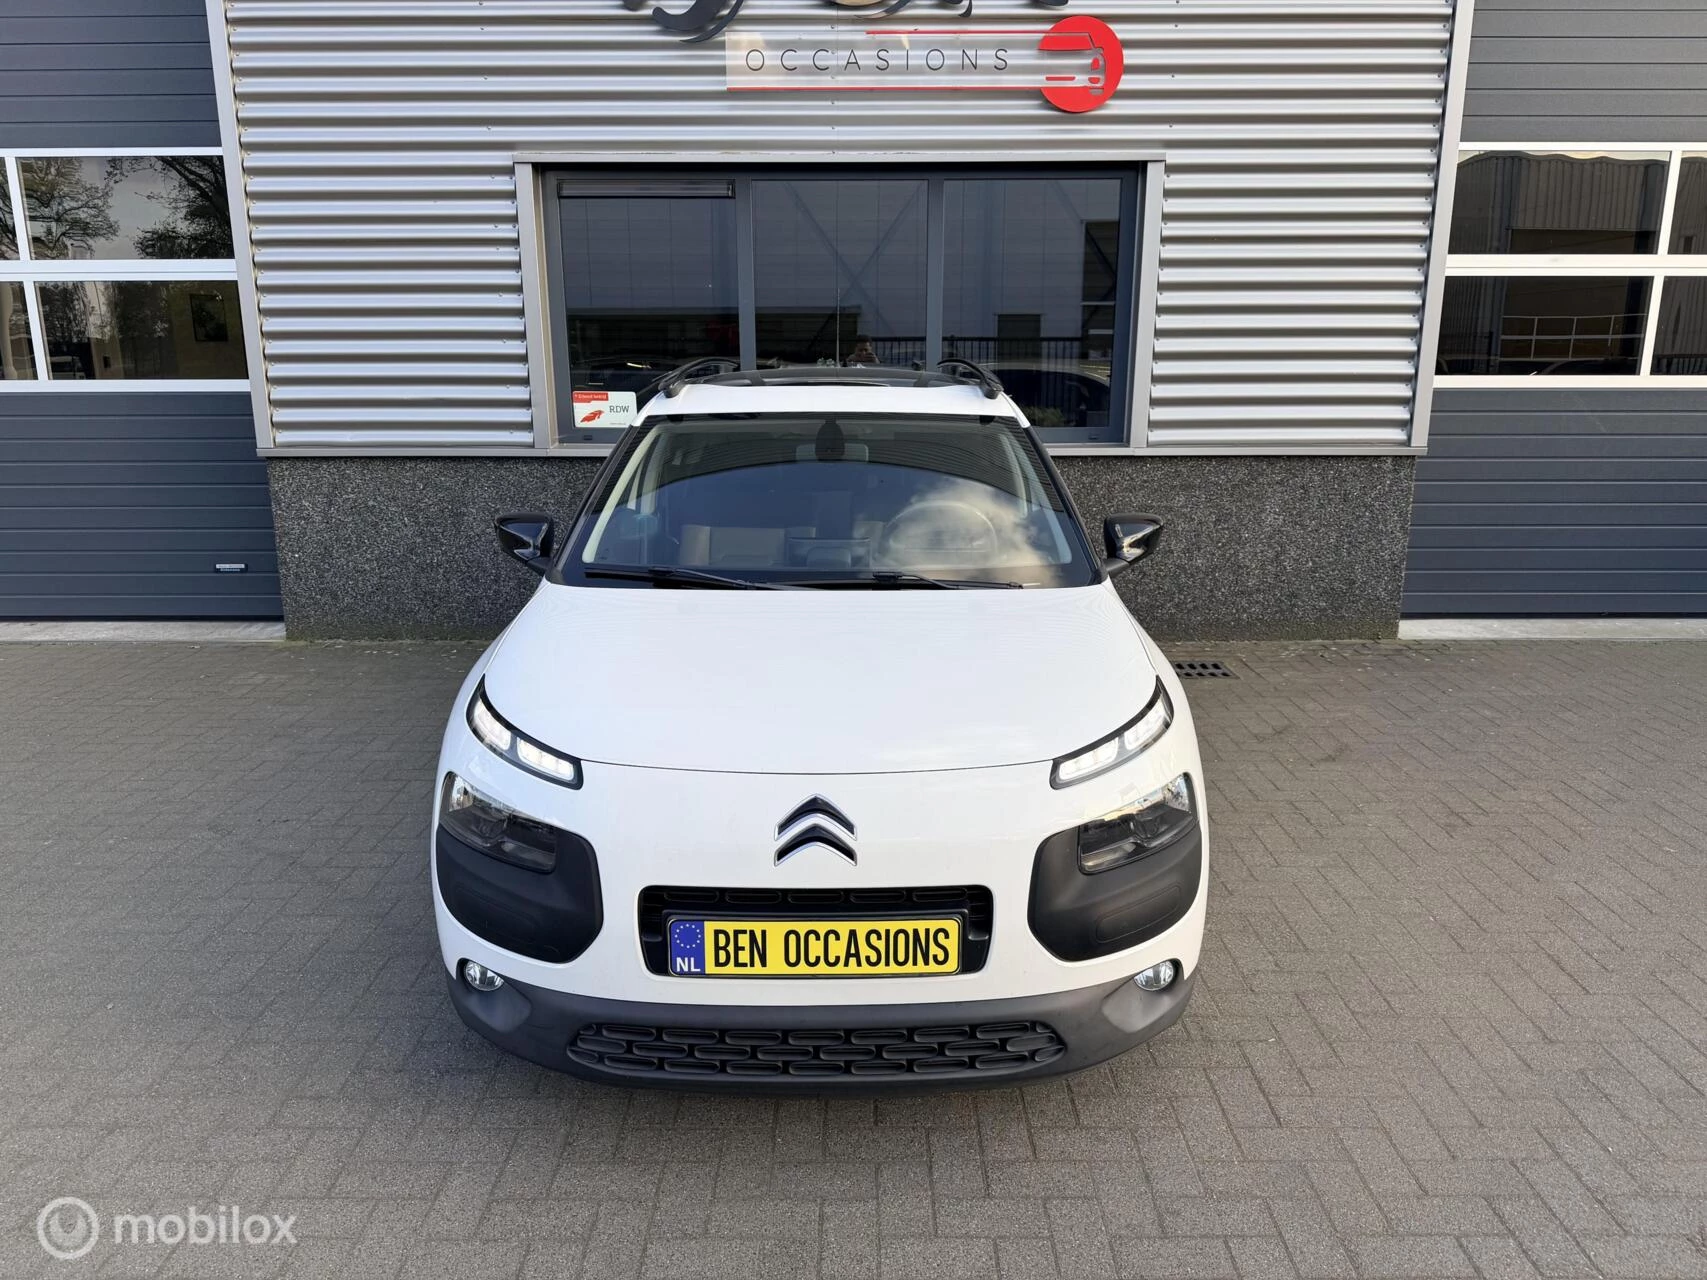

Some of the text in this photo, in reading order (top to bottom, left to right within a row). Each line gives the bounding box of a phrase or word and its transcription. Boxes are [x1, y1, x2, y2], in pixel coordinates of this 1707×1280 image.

[745, 47, 1009, 72] OCCASIONS
[609, 405, 630, 414] RDW
[713, 927, 950, 968] BEN OCCASIONS
[676, 957, 701, 973] NL
